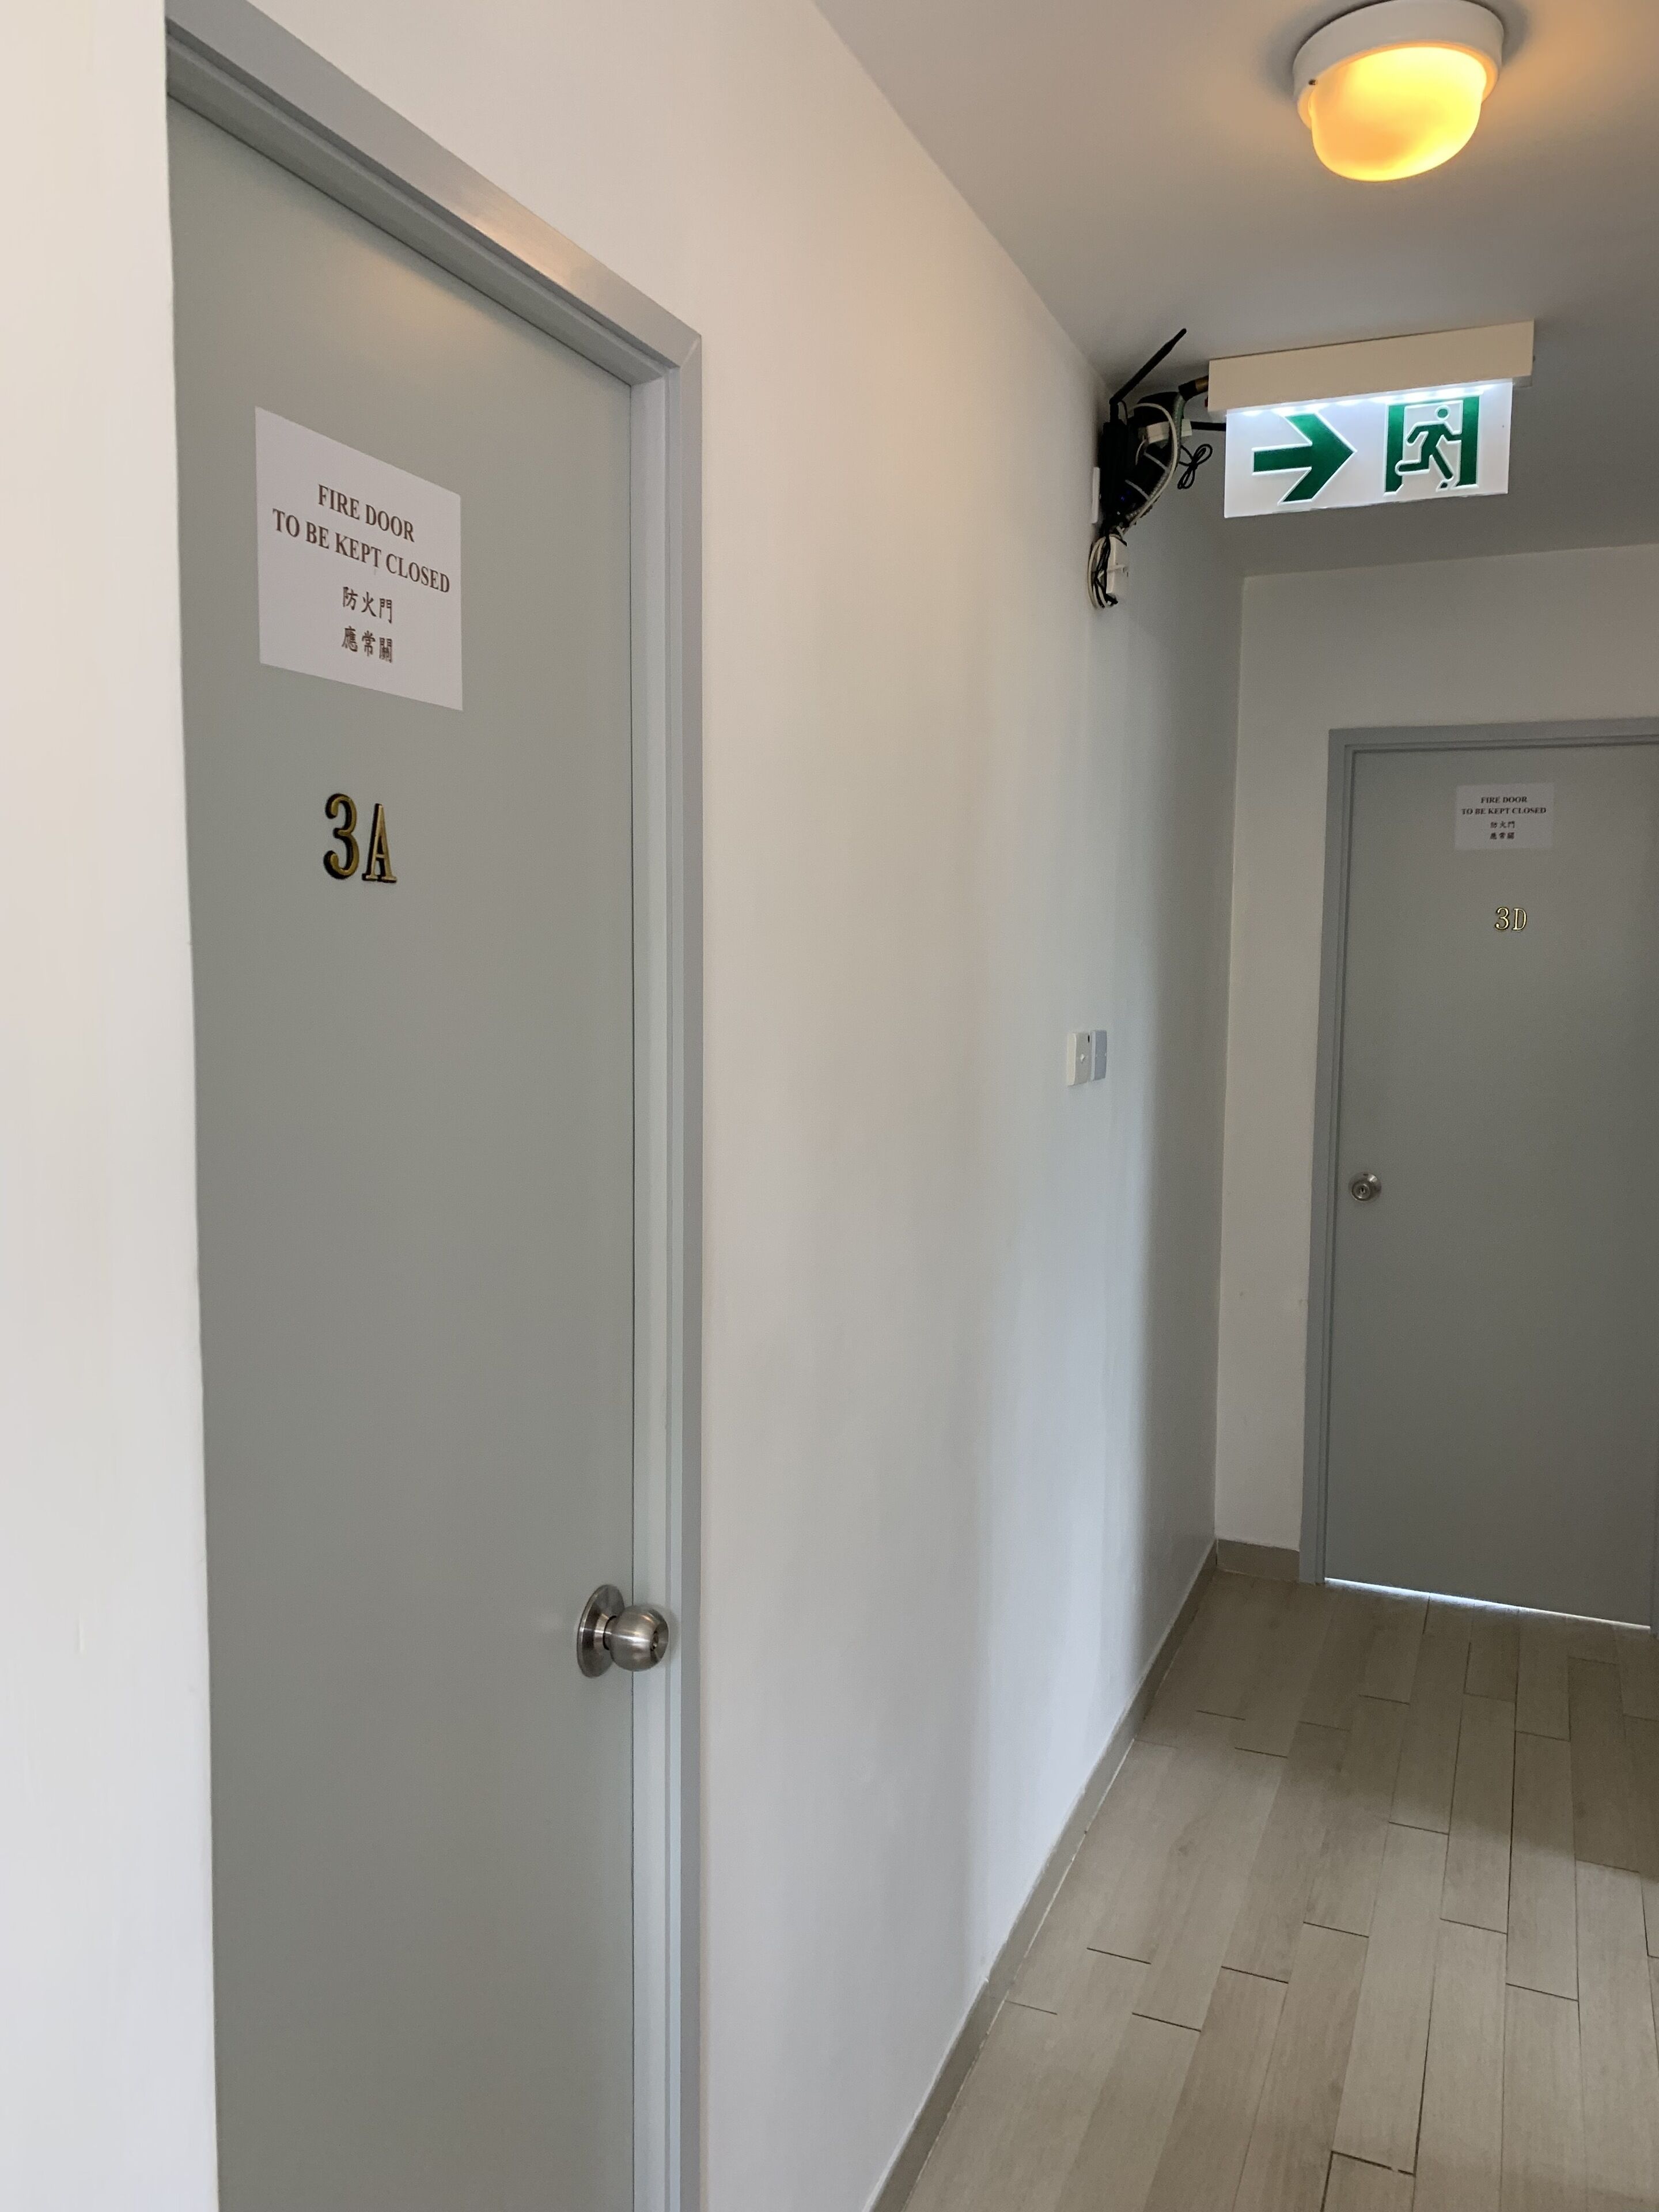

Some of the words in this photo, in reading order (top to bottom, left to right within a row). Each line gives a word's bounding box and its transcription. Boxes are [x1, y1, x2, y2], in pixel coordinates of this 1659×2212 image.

[319, 484, 359, 521] FIRE
[366, 504, 415, 543] DOOR
[272, 508, 300, 537] TO
[306, 521, 329, 549] BE
[335, 533, 381, 568] KEPT
[386, 553, 450, 593] CLOSED
[342, 586, 393, 624] 防火門
[341, 626, 393, 664] 應常關
[323, 793, 397, 883] 3A
[1494, 907, 1527, 931] 3D
